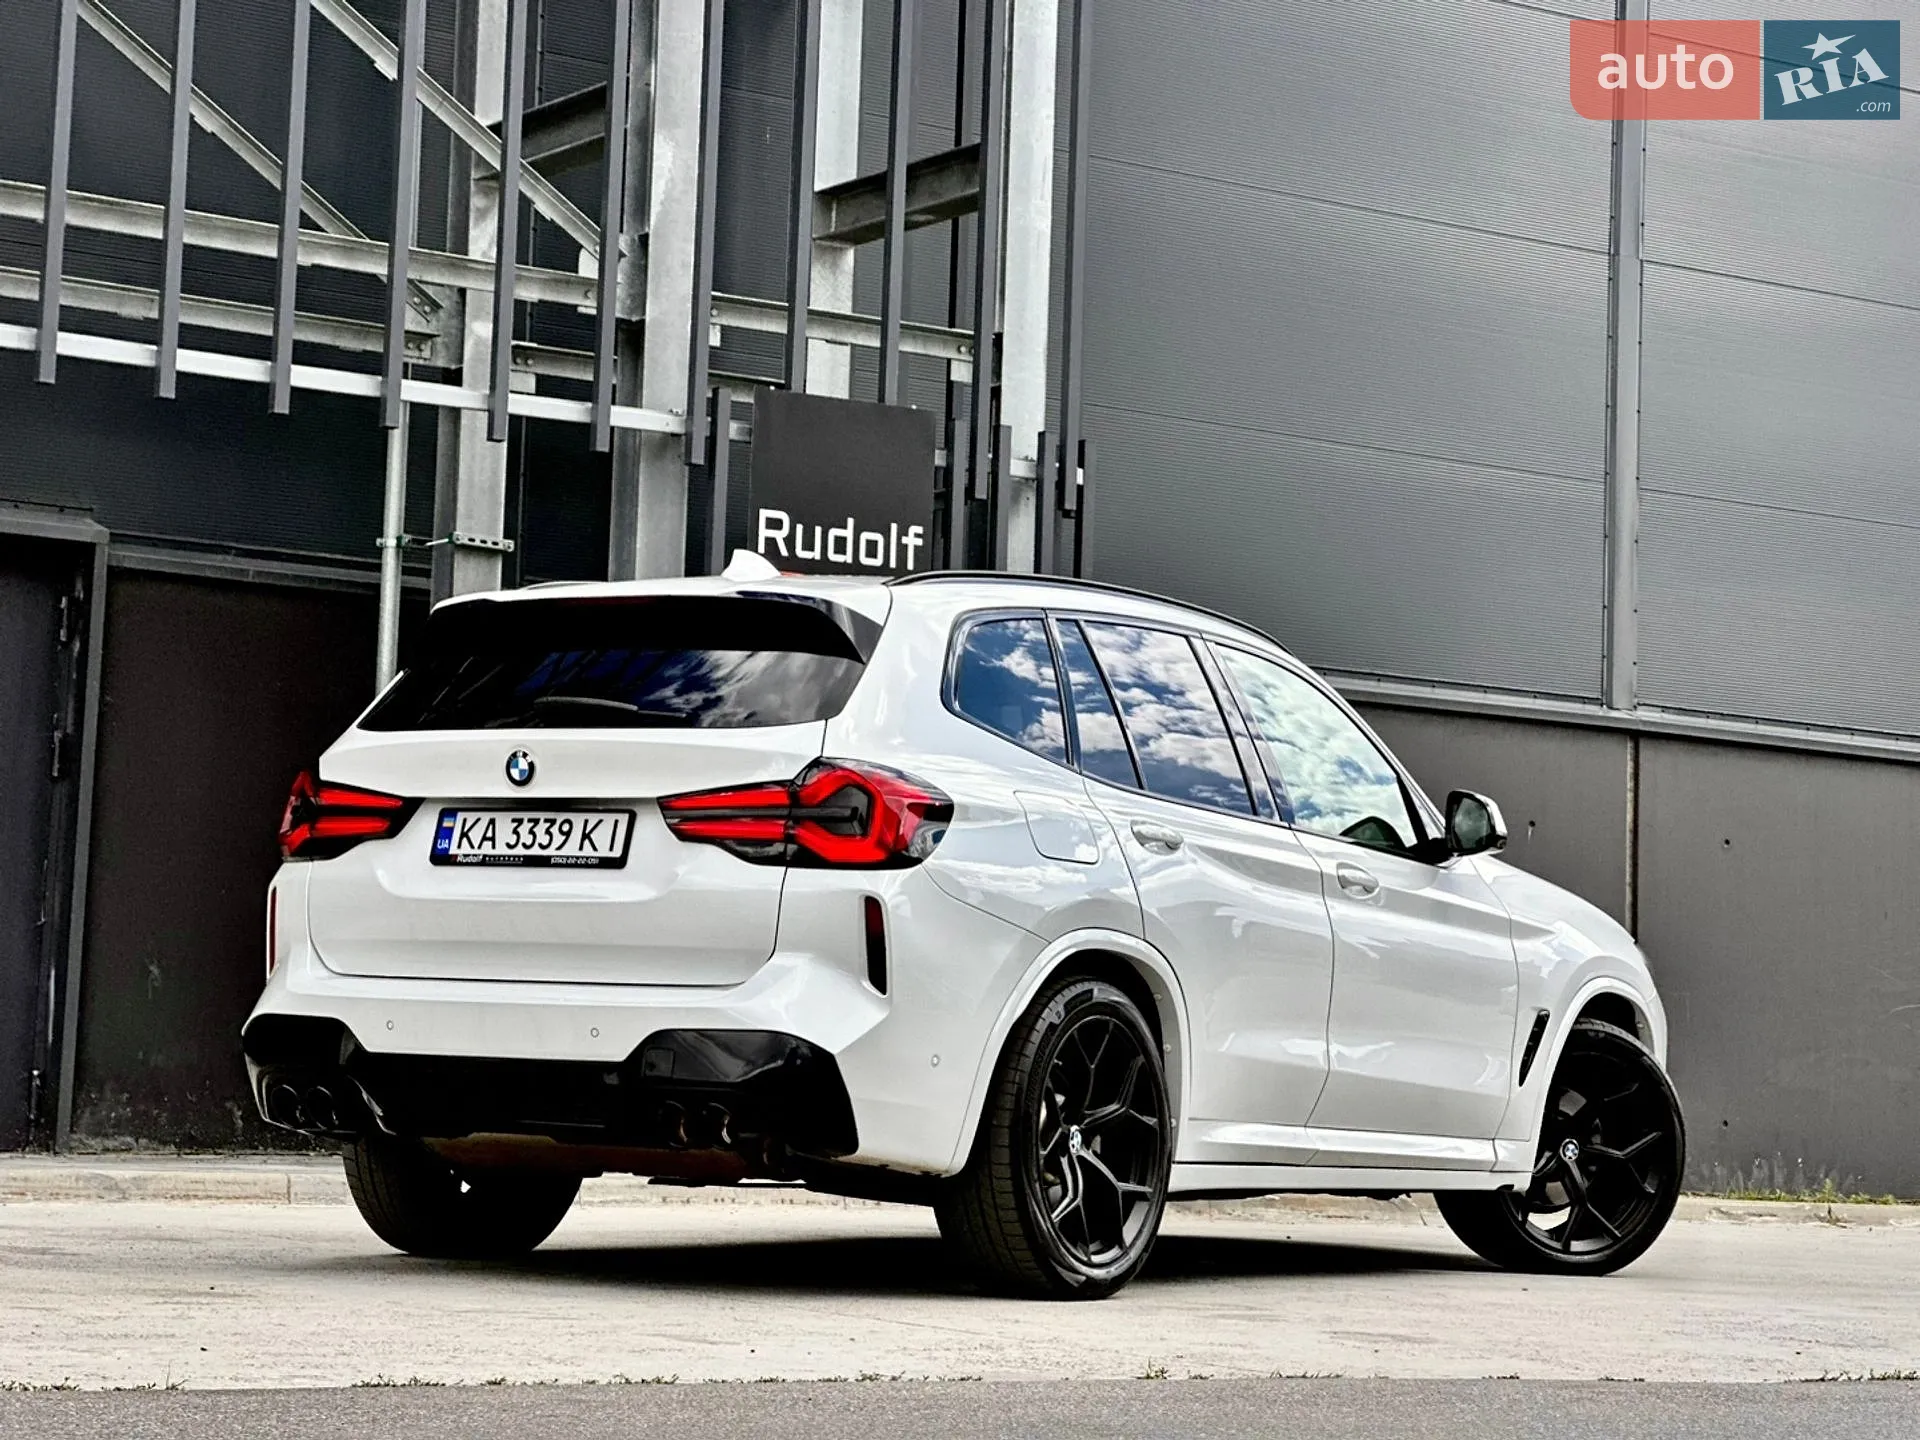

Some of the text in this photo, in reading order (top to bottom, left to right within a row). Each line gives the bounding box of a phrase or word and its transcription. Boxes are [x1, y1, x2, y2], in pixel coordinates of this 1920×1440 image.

[757, 508, 924, 571] Rudolf
[437, 839, 450, 850] UA
[457, 817, 496, 850] KA
[505, 818, 573, 851] 3339
[457, 855, 483, 863] Rudolf
